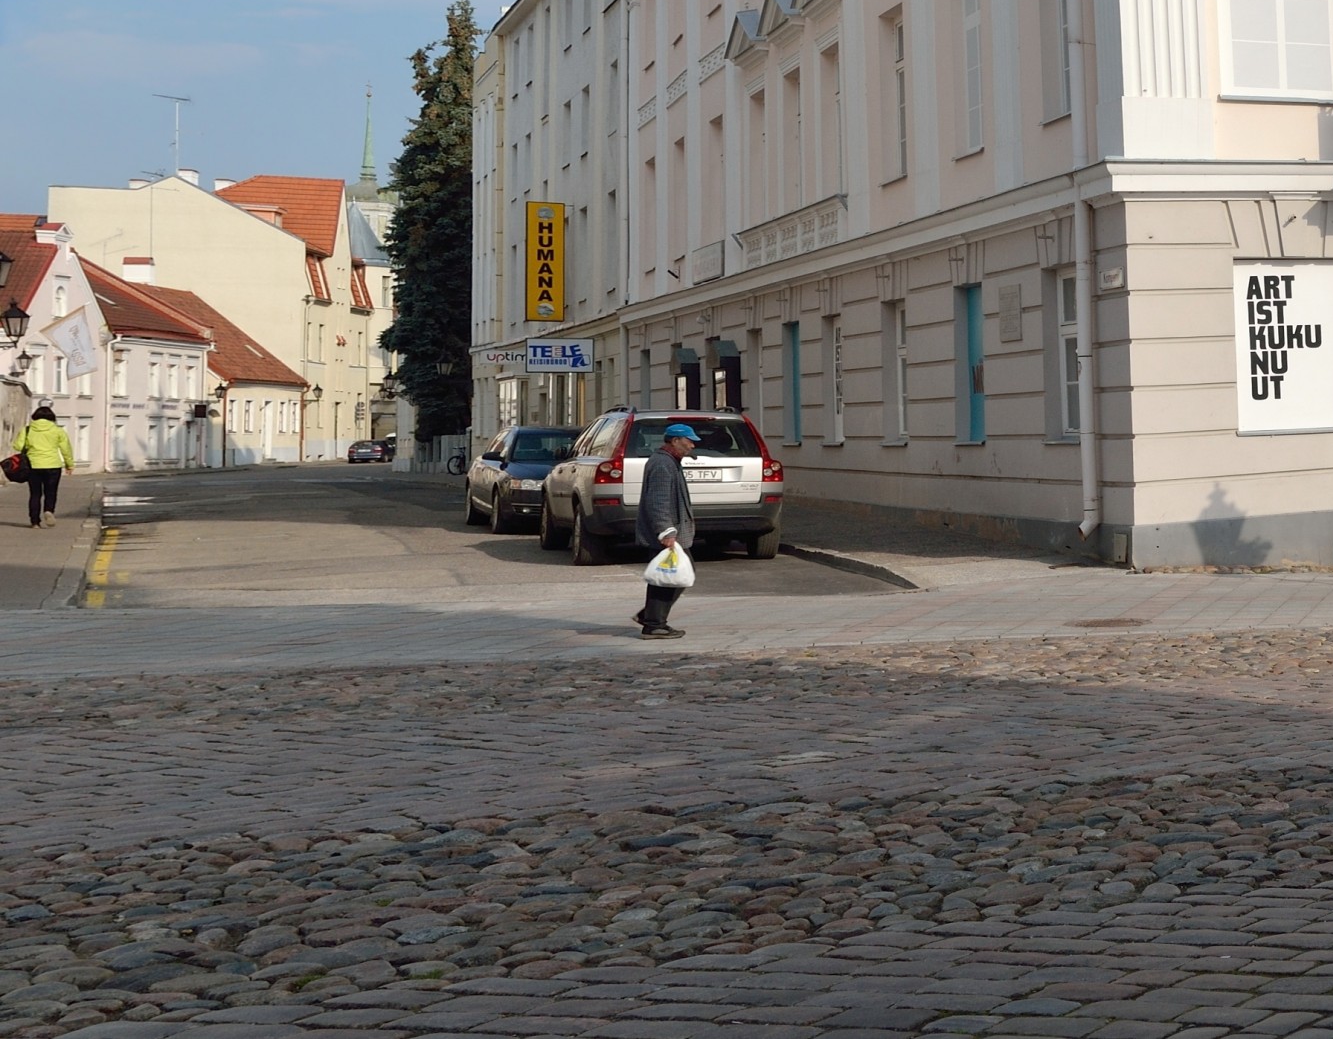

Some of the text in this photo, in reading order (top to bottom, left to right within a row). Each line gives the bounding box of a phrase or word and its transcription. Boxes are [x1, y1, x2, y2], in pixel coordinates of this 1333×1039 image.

[537, 222, 555, 302] HUMANA
[1247, 275, 1295, 299] ART
[1247, 300, 1287, 324] IST
[1249, 324, 1322, 350] KUKU
[529, 344, 582, 358] TEELE
[1250, 350, 1288, 375] NU
[1251, 375, 1284, 400] UT
